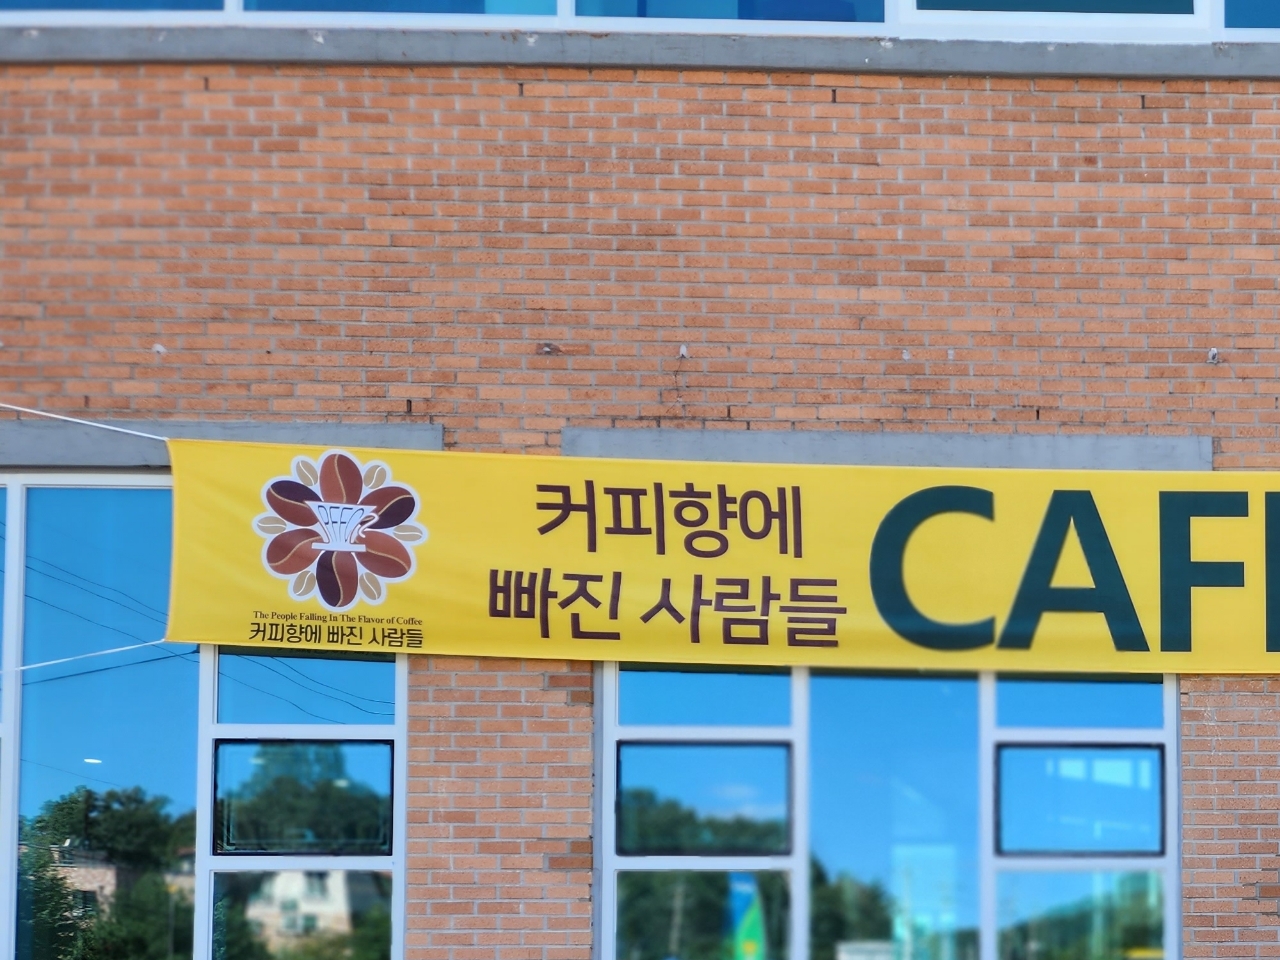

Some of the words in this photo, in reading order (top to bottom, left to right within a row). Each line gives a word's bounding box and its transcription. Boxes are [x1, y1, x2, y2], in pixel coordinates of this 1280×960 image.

[535, 479, 804, 559] 커피향에
[253, 610, 270, 620] The
[271, 611, 298, 622] People
[300, 612, 327, 623] Falling
[329, 613, 338, 622] In
[339, 614, 356, 623] The
[358, 615, 384, 624] Flavor
[386, 616, 396, 625] of
[396, 616, 423, 626] Coffee
[488, 568, 623, 641] 빠진
[639, 574, 848, 648] 사람들
[248, 622, 322, 644] 커피향에
[326, 625, 363, 646] 빠진
[367, 627, 424, 649] 사람들
